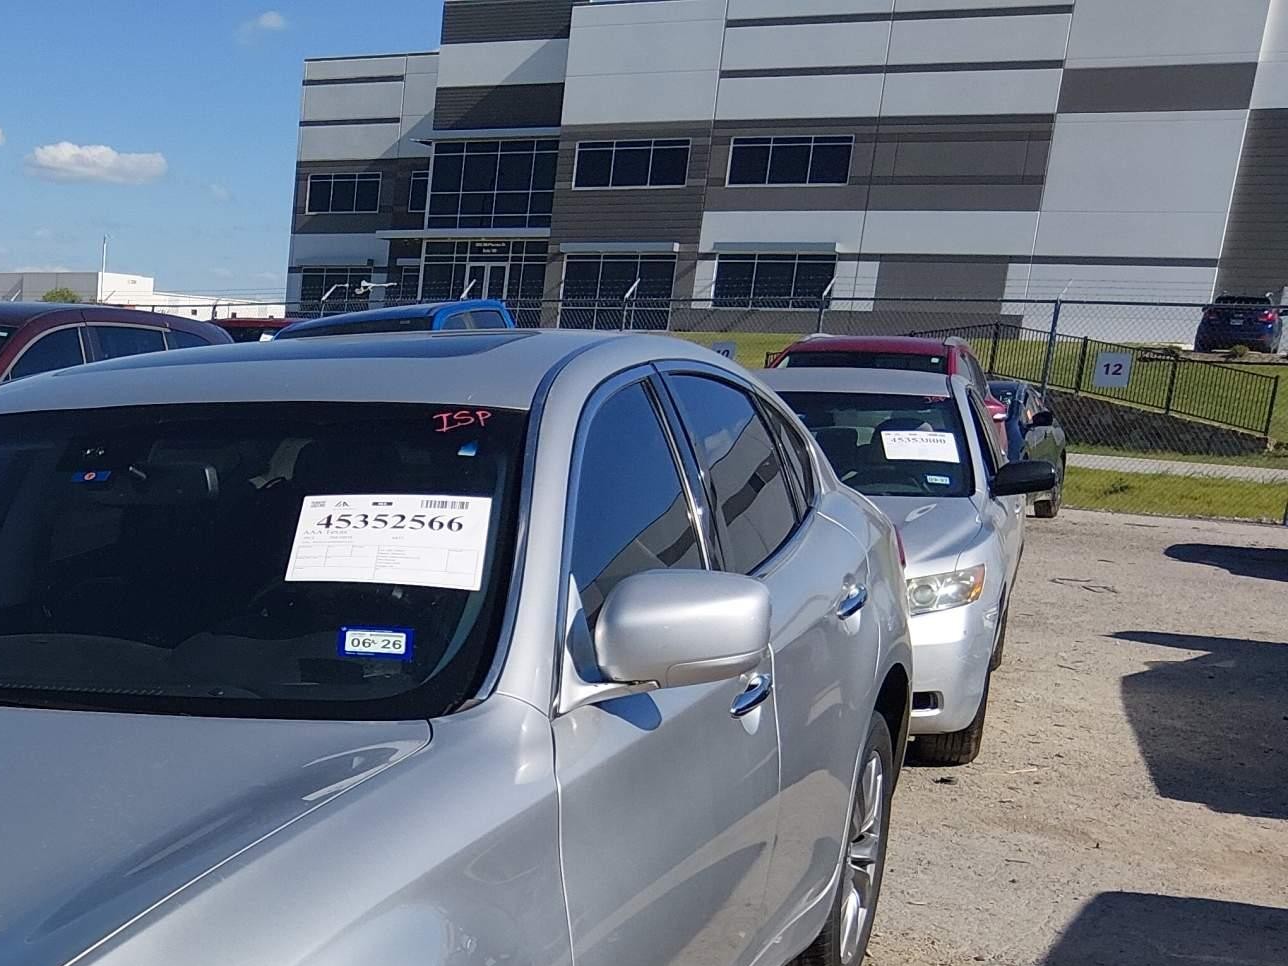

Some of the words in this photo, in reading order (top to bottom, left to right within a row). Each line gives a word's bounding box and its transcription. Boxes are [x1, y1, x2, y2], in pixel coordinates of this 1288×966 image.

[1103, 363, 1123, 376] 12
[432, 410, 492, 432] ISP
[316, 513, 463, 532] 45352566
[381, 639, 402, 649] 26
